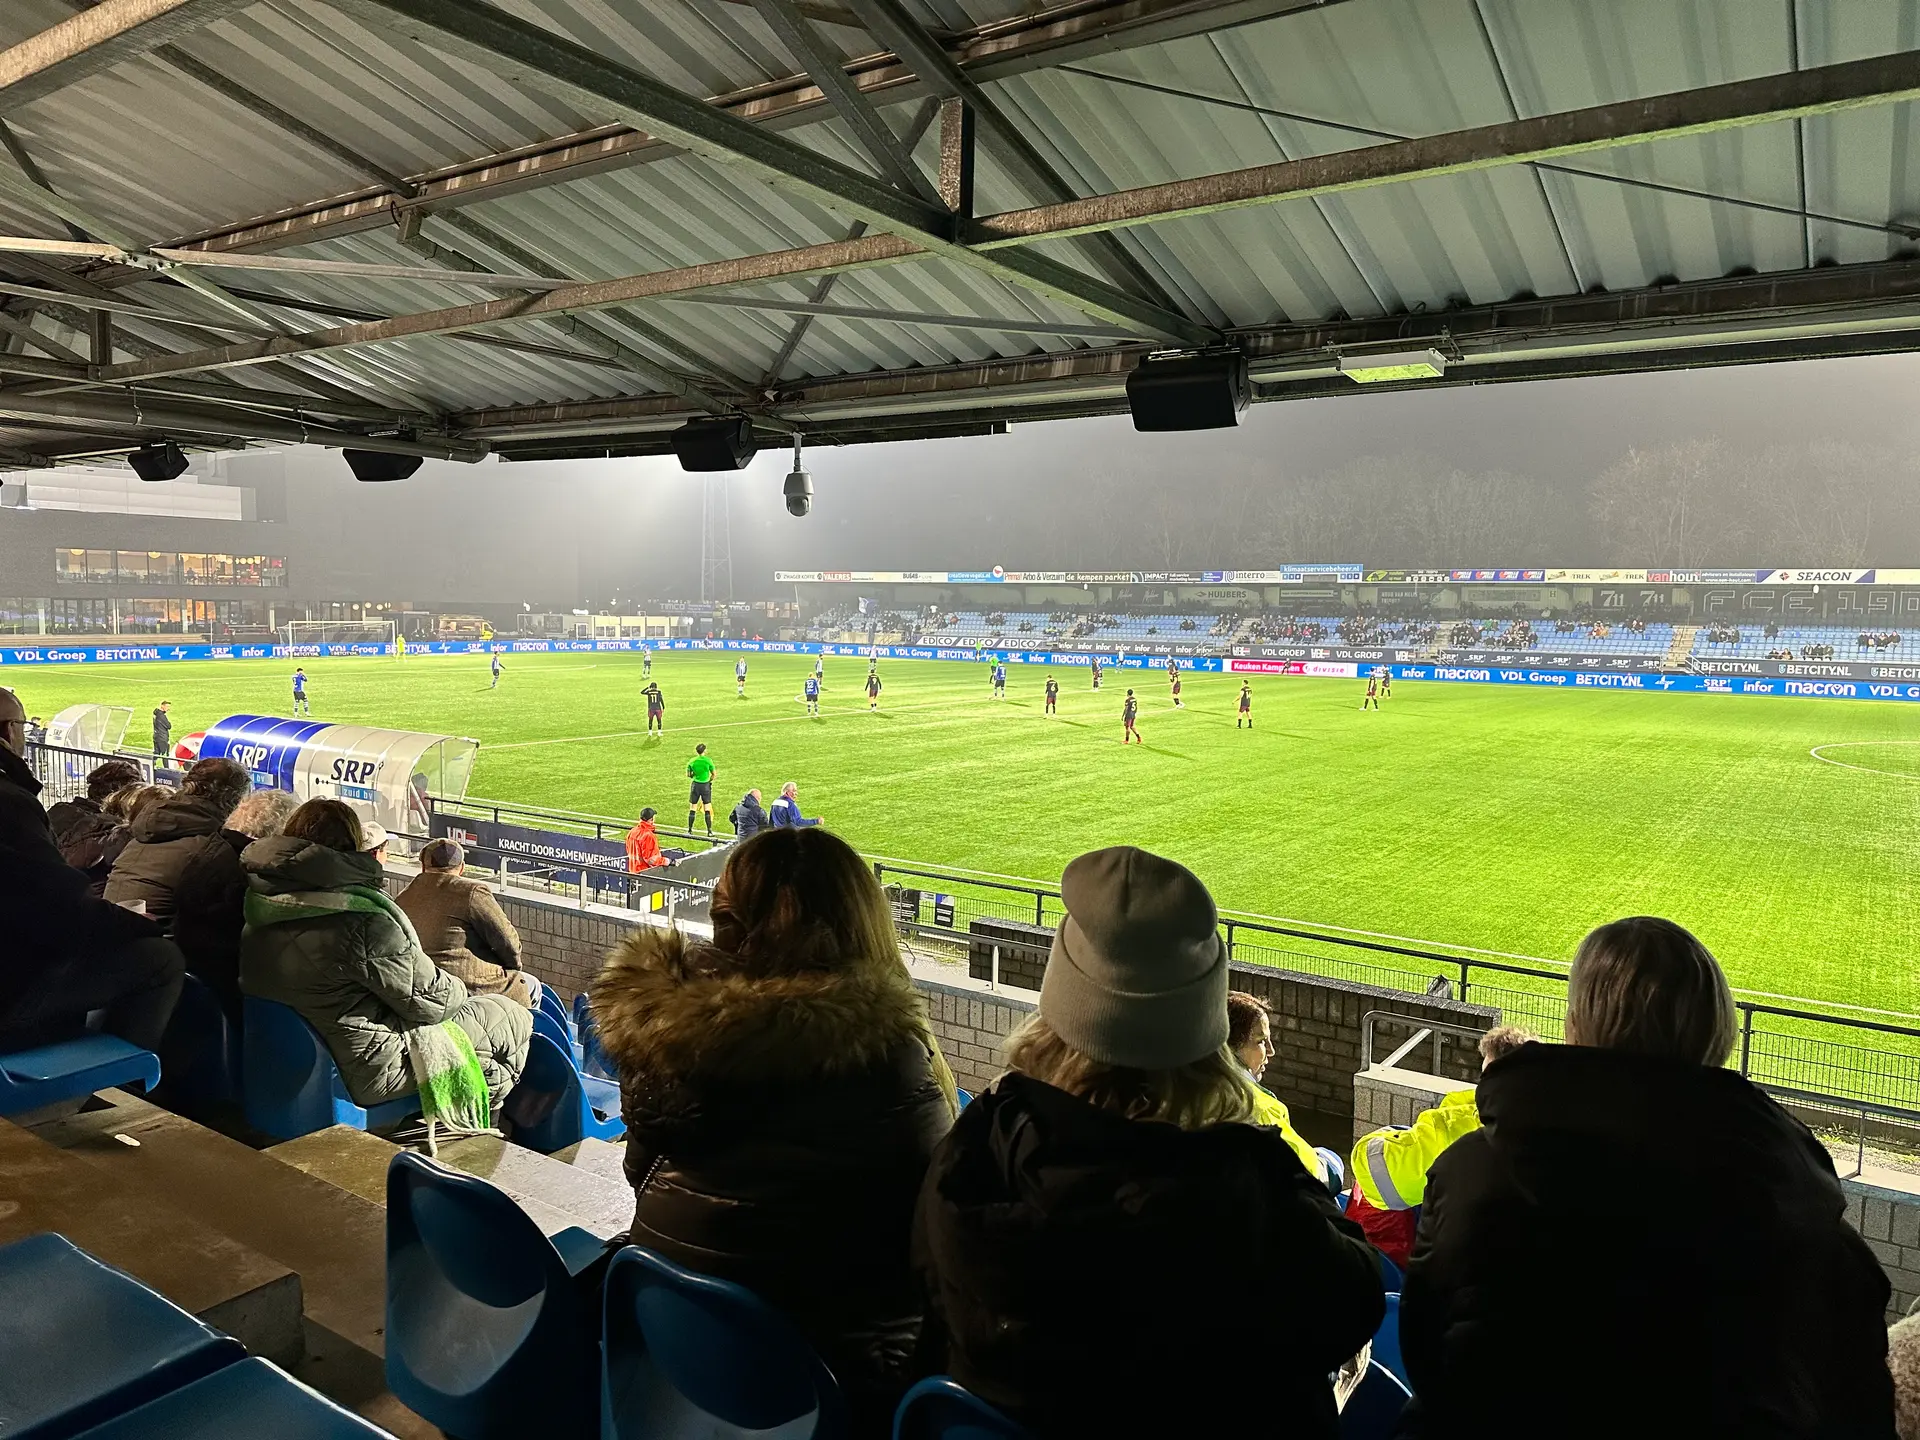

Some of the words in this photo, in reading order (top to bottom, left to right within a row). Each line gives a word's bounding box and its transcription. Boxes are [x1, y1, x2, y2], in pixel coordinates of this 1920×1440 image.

[1283, 565, 1360, 573] klimaatservicebeheer.nl
[823, 573, 851, 581] VALERES
[1023, 572, 1036, 581] Arbo
[1036, 573, 1042, 581] &
[1042, 572, 1065, 581] Verzuim
[1066, 572, 1075, 581] de
[1077, 572, 1103, 583] kempen
[1104, 572, 1130, 583] parket
[1235, 571, 1265, 579] interro
[1647, 571, 1701, 583] vanhout
[1796, 571, 1852, 581] SEACON
[1207, 590, 1247, 599] HUIJBERS
[1600, 590, 1625, 607] 711
[512, 642, 548, 651] macron
[553, 642, 571, 650] VDL
[571, 642, 593, 651] Groep
[596, 641, 632, 650] BETCITY.NL
[675, 641, 688, 649] infor
[727, 641, 741, 649] VDL
[741, 641, 760, 651] Groep
[922, 637, 953, 646] EDCO
[1004, 639, 1037, 649] EDCO
[1058, 642, 1074, 650] infor
[1077, 642, 1093, 650] infor
[1095, 642, 1112, 651] infor
[211, 647, 229, 655] SRP
[242, 647, 265, 657] infor
[350, 645, 379, 654] Groep
[385, 644, 432, 654] BECITY.NL
[490, 642, 507, 652] infor
[763, 642, 796, 652] BETCITY.NL
[840, 645, 853, 655] infor
[1134, 643, 1151, 652] infor
[1154, 644, 1172, 653] infor
[1175, 645, 1192, 654] infor
[14, 650, 44, 662] VDL
[47, 650, 87, 662] Groep
[95, 648, 161, 661] BETCITY.NL
[894, 648, 910, 657] VDL
[910, 648, 933, 659] Groep
[936, 649, 976, 660] BETCITY.NL
[1261, 648, 1278, 656] VDL
[1278, 648, 1306, 657] GROEP
[1335, 650, 1352, 658] VDL
[1354, 651, 1383, 659] GROEP
[1029, 653, 1046, 663] infor
[1051, 653, 1090, 665] macron
[1096, 655, 1115, 665] VDL
[1116, 657, 1142, 668] roep
[1553, 657, 1569, 665] SRP
[1233, 661, 1259, 671] Keuken
[1312, 665, 1345, 674] divisie
[1701, 661, 1762, 674] BETCITY.NL
[1786, 664, 1852, 677] BETCITY.NL
[1402, 667, 1426, 679] infor
[1434, 668, 1490, 681] macron
[1500, 670, 1526, 682] VDL
[1528, 672, 1567, 685] Groep
[1576, 673, 1644, 688] BETCITY.NL
[1703, 678, 1727, 688] SRP
[1743, 680, 1774, 693] infor
[1785, 681, 1856, 696] macron
[1869, 685, 1903, 697] VDL
[650, 694, 658, 703] 11
[231, 744, 268, 769] SRP
[330, 757, 376, 785] SRP
[498, 838, 531, 854] KRACHT
[531, 844, 555, 858] DOOR
[555, 847, 627, 870] SAMENWERKING
